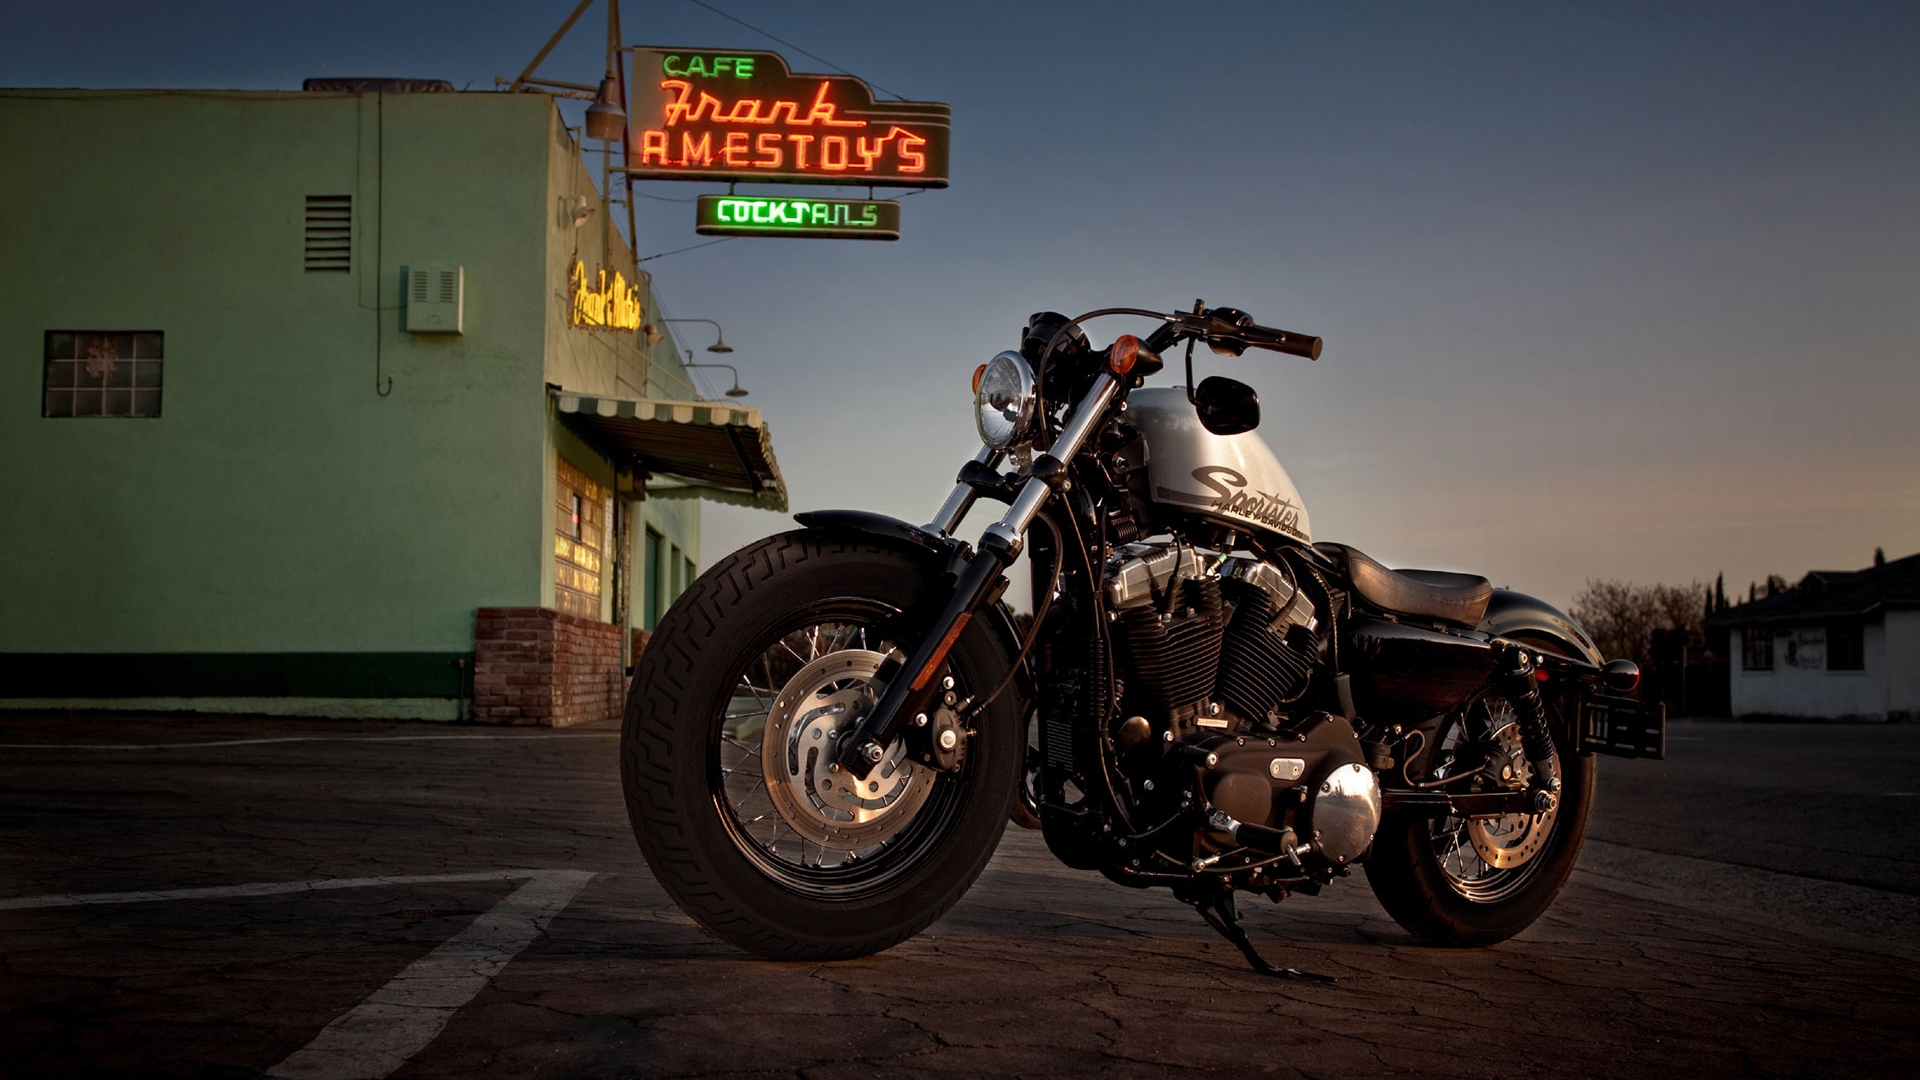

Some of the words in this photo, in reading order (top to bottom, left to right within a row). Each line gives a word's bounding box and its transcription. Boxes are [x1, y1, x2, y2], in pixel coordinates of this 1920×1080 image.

[664, 55, 755, 78] CAFE
[660, 79, 868, 127] Frank
[642, 126, 927, 172] AMESTOY'S
[717, 199, 878, 226] COCKTAILS
[1191, 465, 1301, 529] Sportster
